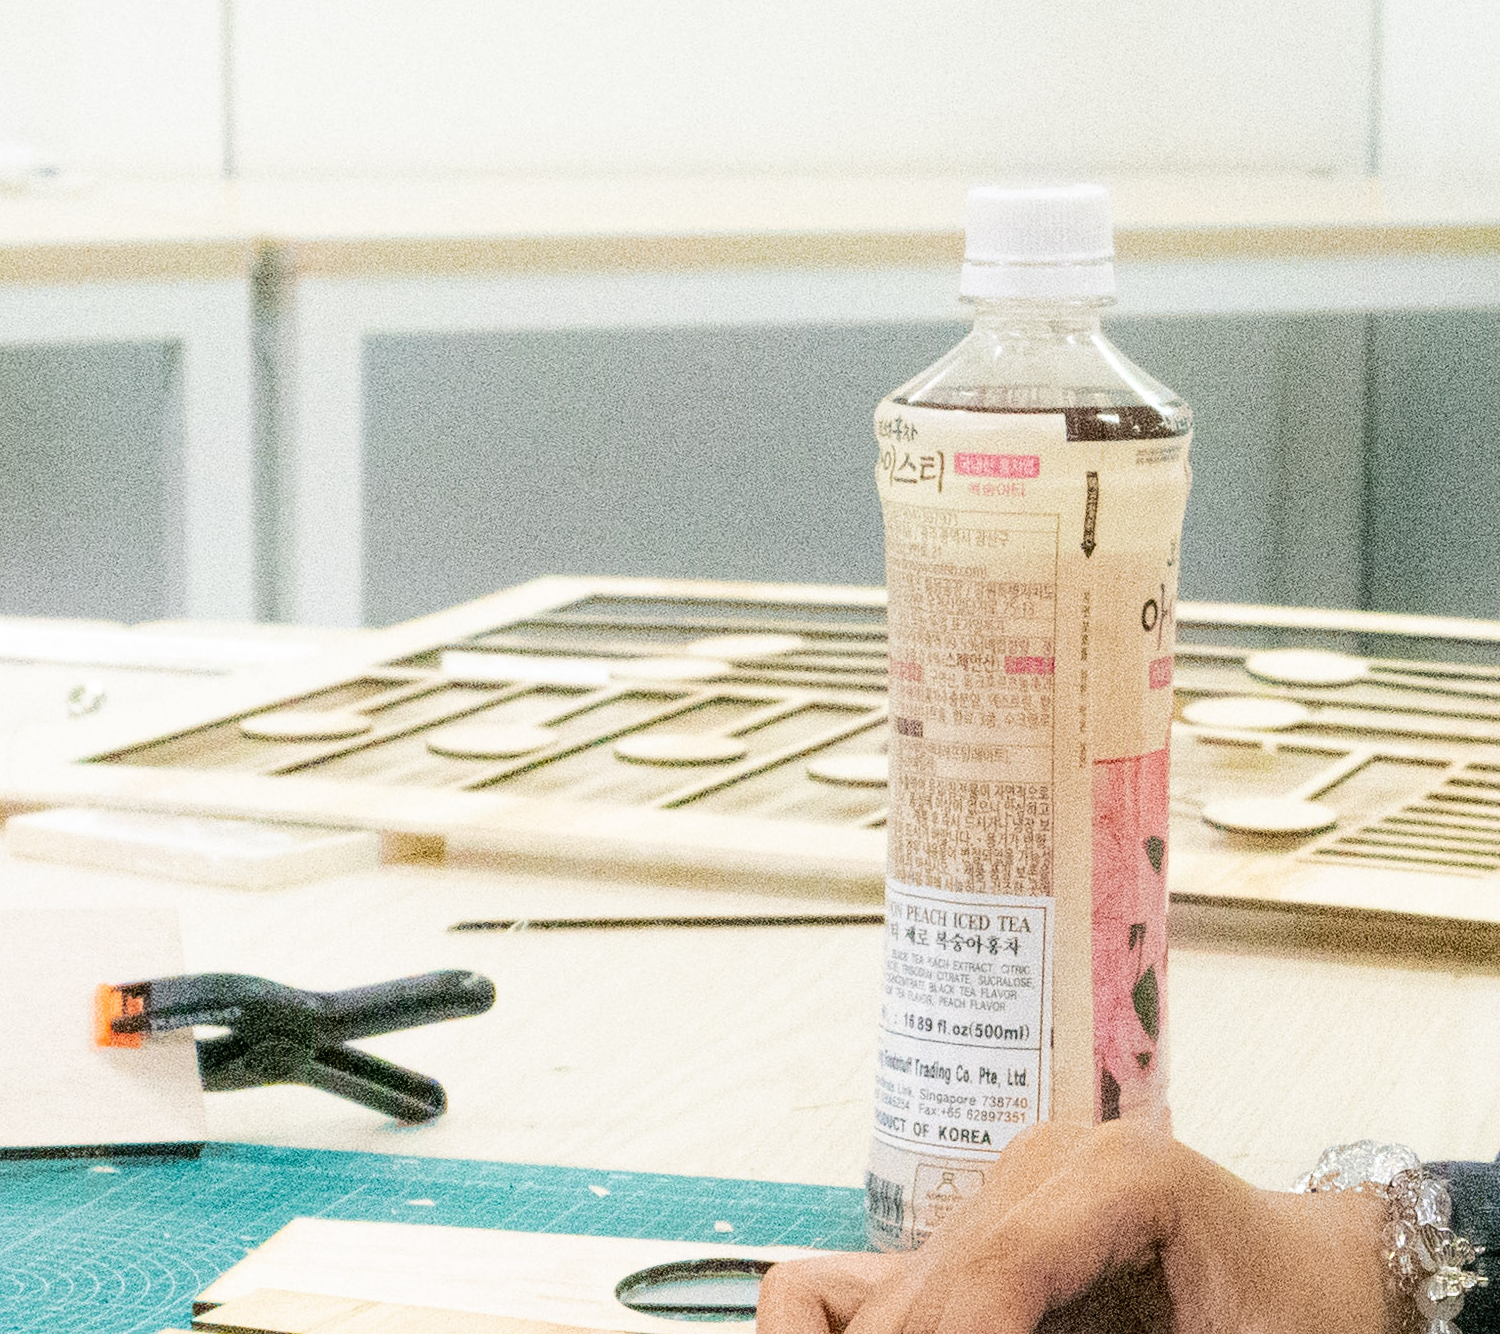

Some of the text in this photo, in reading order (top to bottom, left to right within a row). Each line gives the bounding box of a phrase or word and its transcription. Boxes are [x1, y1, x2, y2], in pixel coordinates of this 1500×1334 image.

[906, 905, 948, 927] PEACH
[954, 912, 991, 932] ICED
[997, 915, 1031, 934] TEA
[960, 986, 977, 998] TEA
[980, 988, 1018, 1001] FLAVOR
[970, 999, 1007, 1012] FLAVOR
[915, 1058, 952, 1085] Trading
[956, 1064, 974, 1084] Co.
[1007, 1067, 1031, 1088] Ltd.
[919, 1087, 978, 1107] Singapore
[966, 1109, 1028, 1124] 62897351
[913, 1121, 930, 1138] OF
[938, 1125, 993, 1146] KOREA
